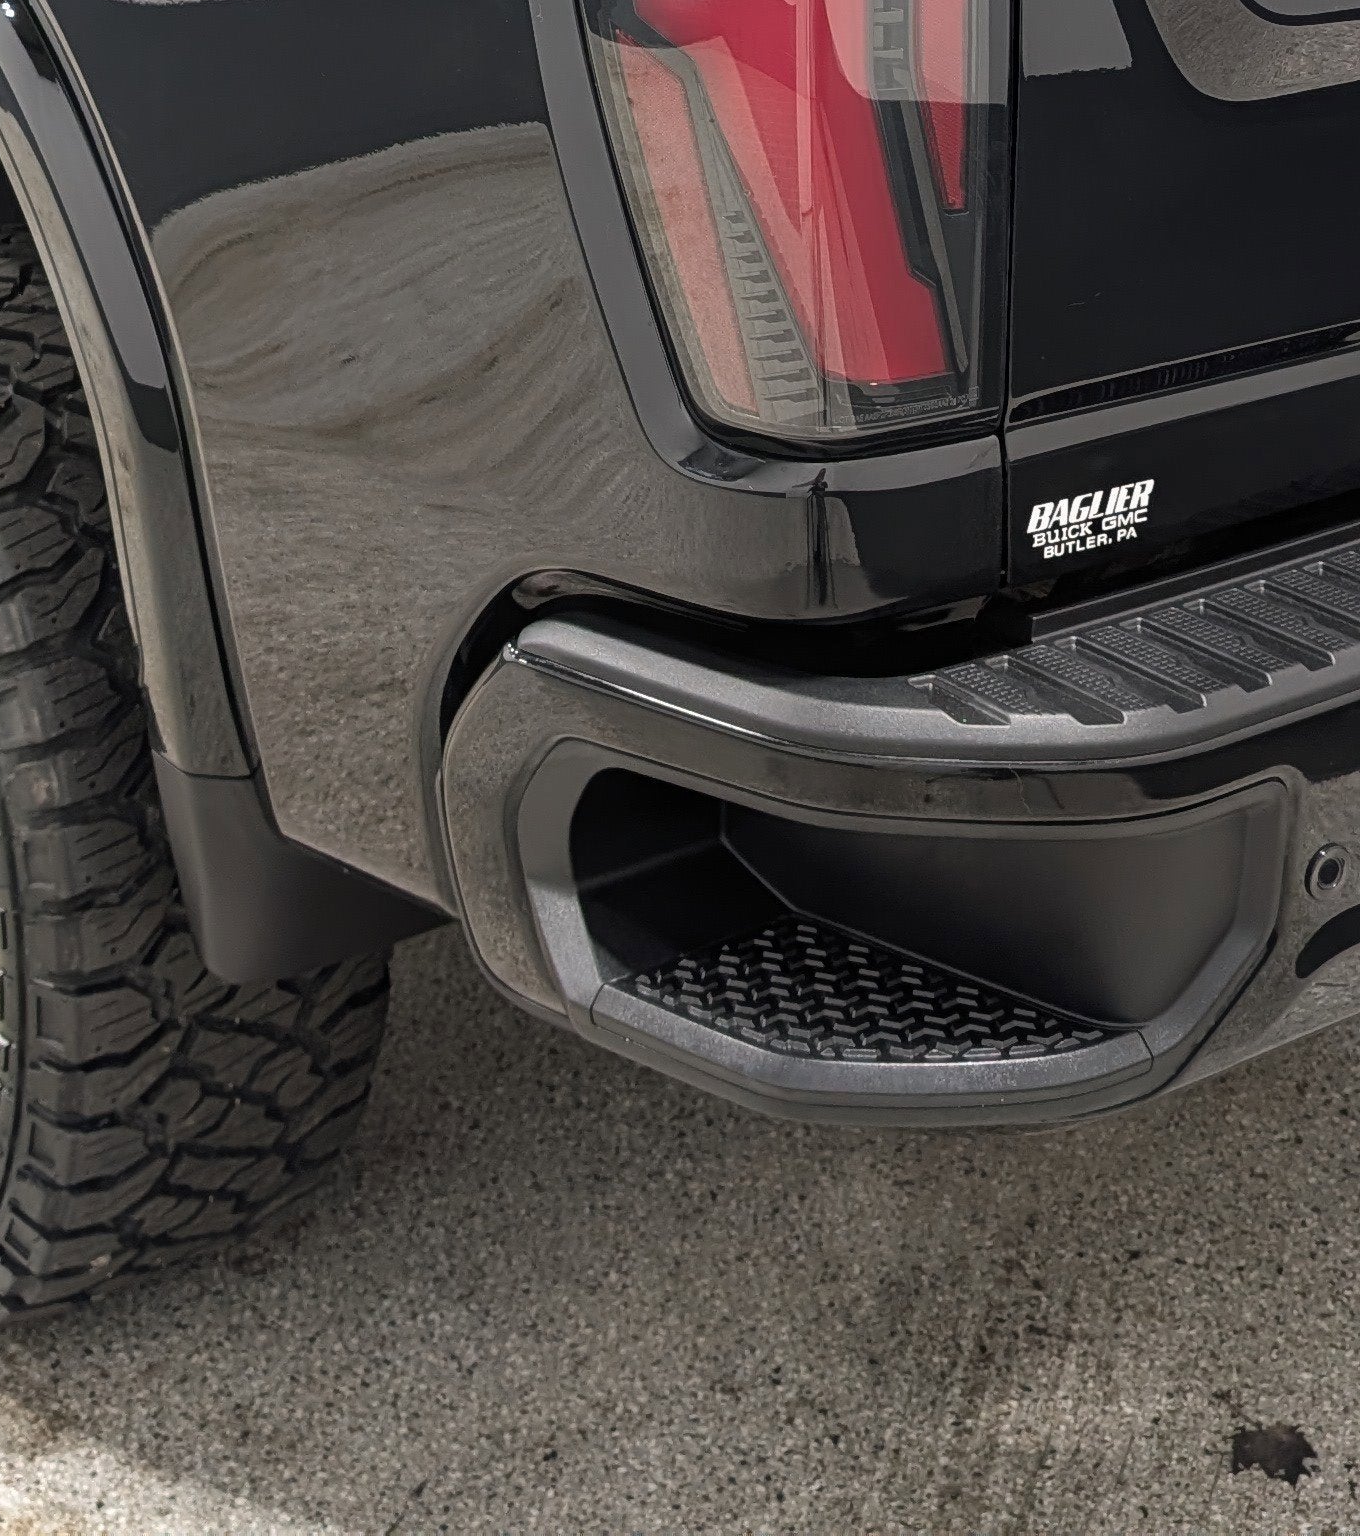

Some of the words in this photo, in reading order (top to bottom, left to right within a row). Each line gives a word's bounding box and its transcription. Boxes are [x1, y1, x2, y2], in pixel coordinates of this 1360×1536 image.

[1026, 479, 1155, 534] BAGLIER
[1032, 521, 1094, 548] BUICK
[1101, 508, 1148, 531] GMC
[1043, 533, 1113, 559] BUTLER,
[1116, 526, 1138, 543] PA
